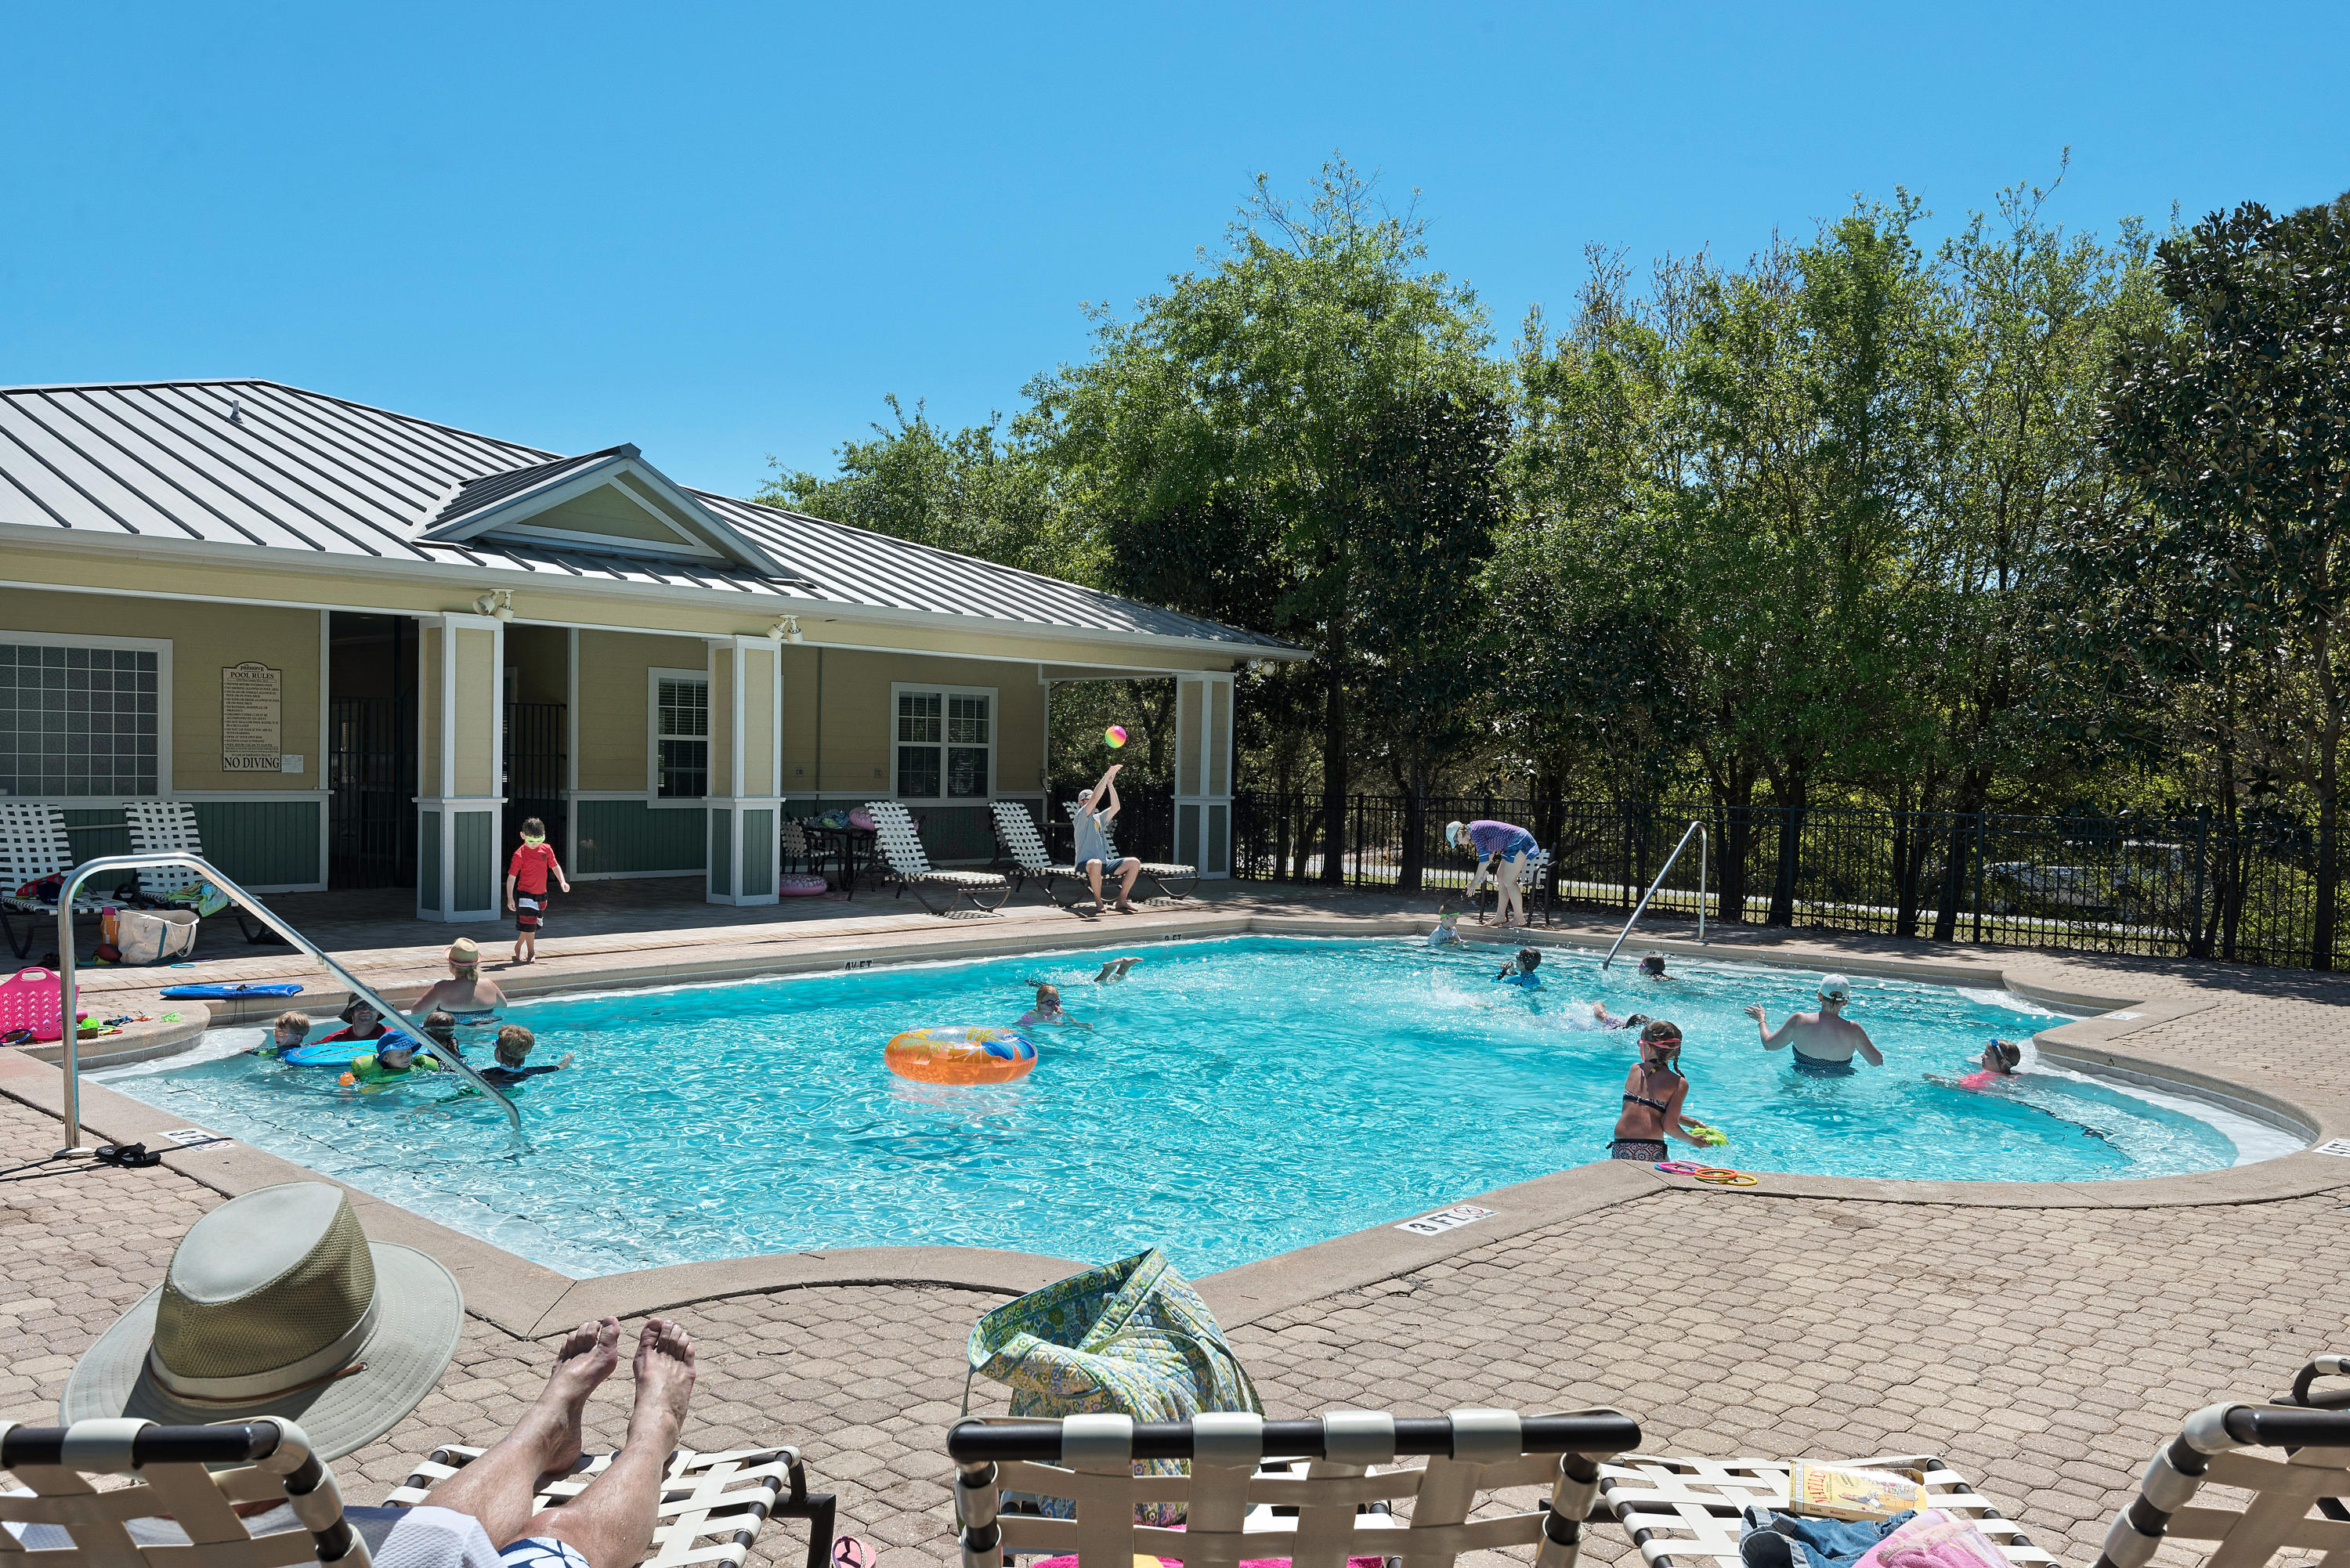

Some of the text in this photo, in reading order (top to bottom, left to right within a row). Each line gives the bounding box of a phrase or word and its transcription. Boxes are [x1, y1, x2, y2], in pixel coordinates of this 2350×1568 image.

[225, 757, 240, 768] NO
[243, 757, 280, 768] DIVING
[1409, 1223, 1438, 1231] 3
[1807, 1466, 1831, 1503] MATILD
